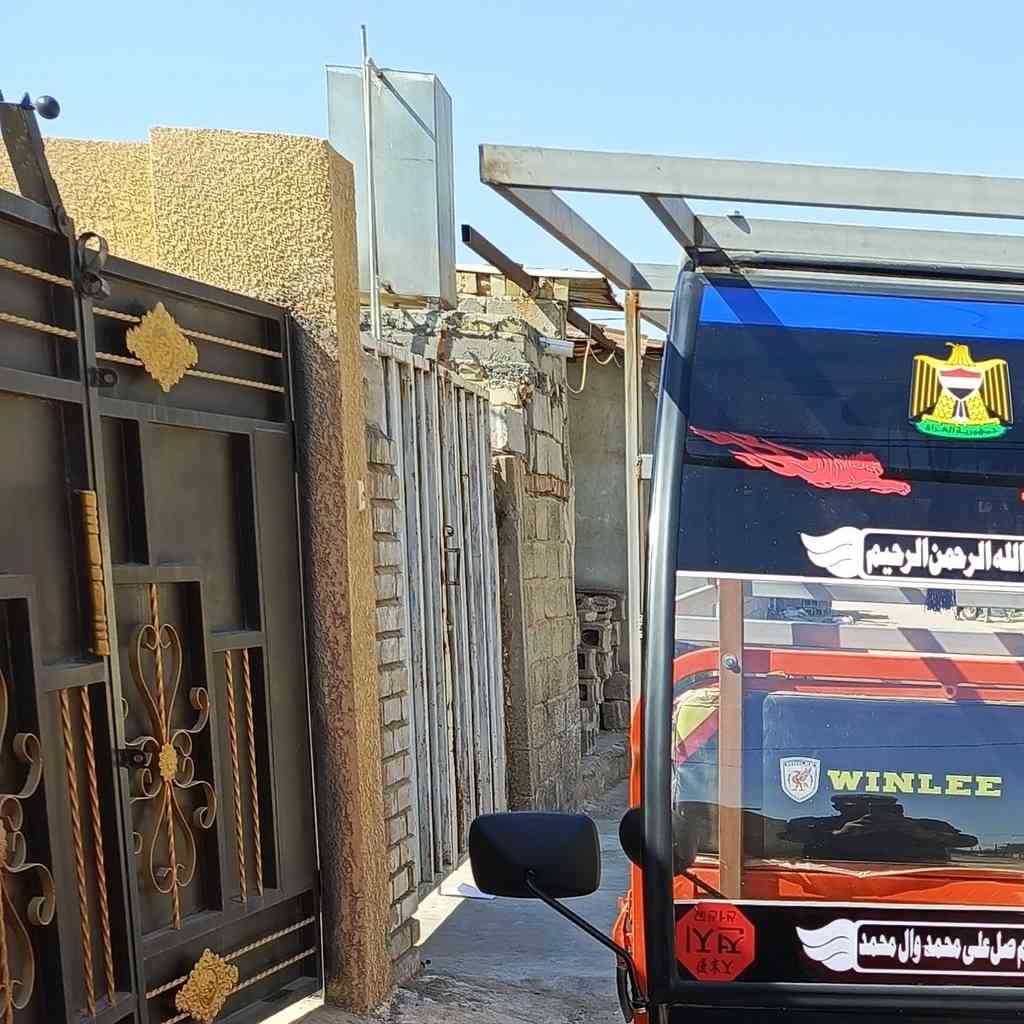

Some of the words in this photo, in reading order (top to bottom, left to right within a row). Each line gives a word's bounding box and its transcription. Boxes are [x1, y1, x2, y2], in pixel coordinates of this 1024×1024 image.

[866, 537, 929, 575] الرحيم
[928, 540, 992, 578] الرحمن
[827, 769, 1002, 797] WINLEE
[859, 932, 897, 958] محمد
[923, 934, 961, 960] محمد
[962, 930, 990, 966] على
[989, 930, 1016, 966] صل
